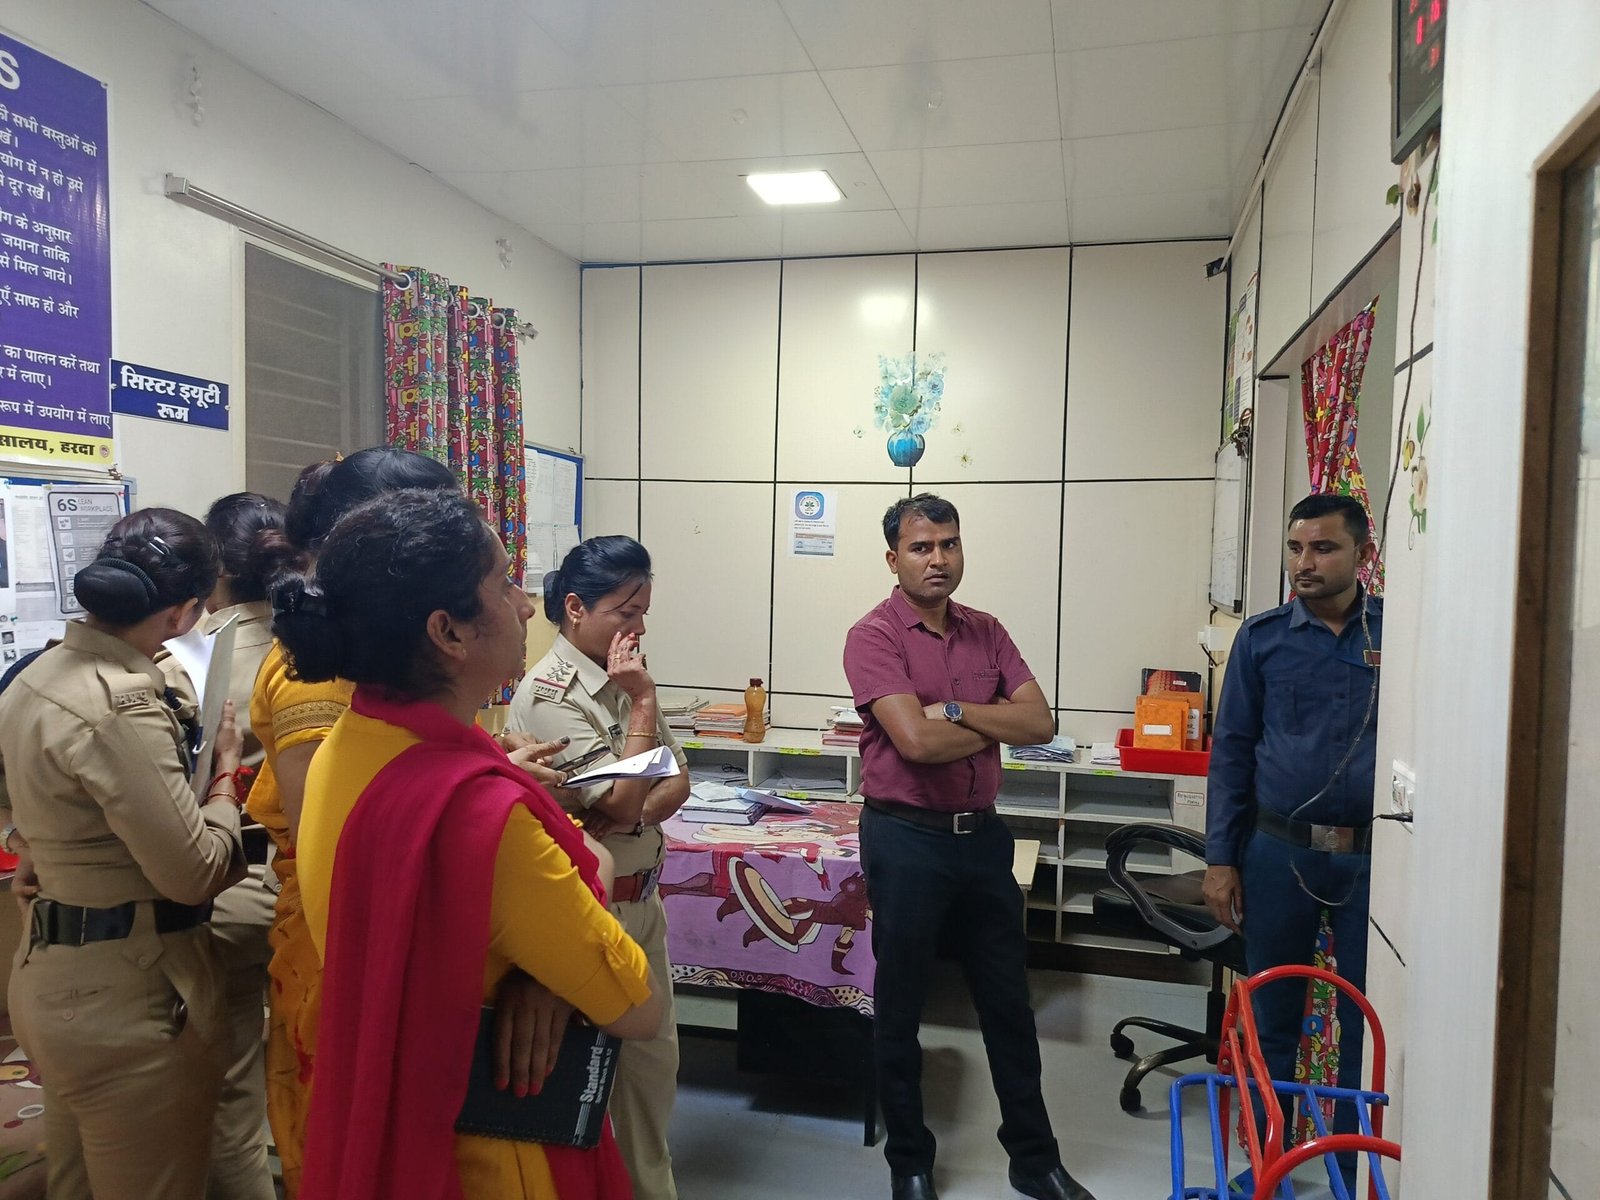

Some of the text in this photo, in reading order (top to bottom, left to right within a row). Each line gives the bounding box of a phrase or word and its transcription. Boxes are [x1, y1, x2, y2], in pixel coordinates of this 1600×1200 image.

[11, 112, 38, 133] सभी
[41, 125, 79, 150] वस्तुओं
[81, 141, 97, 157] को
[7, 177, 24, 197] दूर
[26, 159, 37, 176] में
[39, 166, 49, 181] न
[51, 169, 64, 187] हो
[14, 213, 28, 230] के
[32, 220, 73, 244] अनुसार
[1, 232, 70, 263] जमाना ताकि
[13, 255, 39, 276] मिल
[13, 291, 40, 308] साफ
[42, 296, 54, 314] हो
[57, 300, 79, 319] और
[3, 344, 100, 374] का पालन करें तथा
[6, 364, 17, 381] में
[120, 364, 221, 409] सिस्टर ड्यूटी
[22, 399, 34, 416] में
[36, 404, 74, 421] उपयोग
[76, 407, 87, 423] में
[88, 413, 111, 430] लाए
[156, 402, 190, 423] रूम
[60, 441, 95, 456] हरदा
[57, 498, 78, 512] 6S
[579, 1045, 604, 1103] Standard
